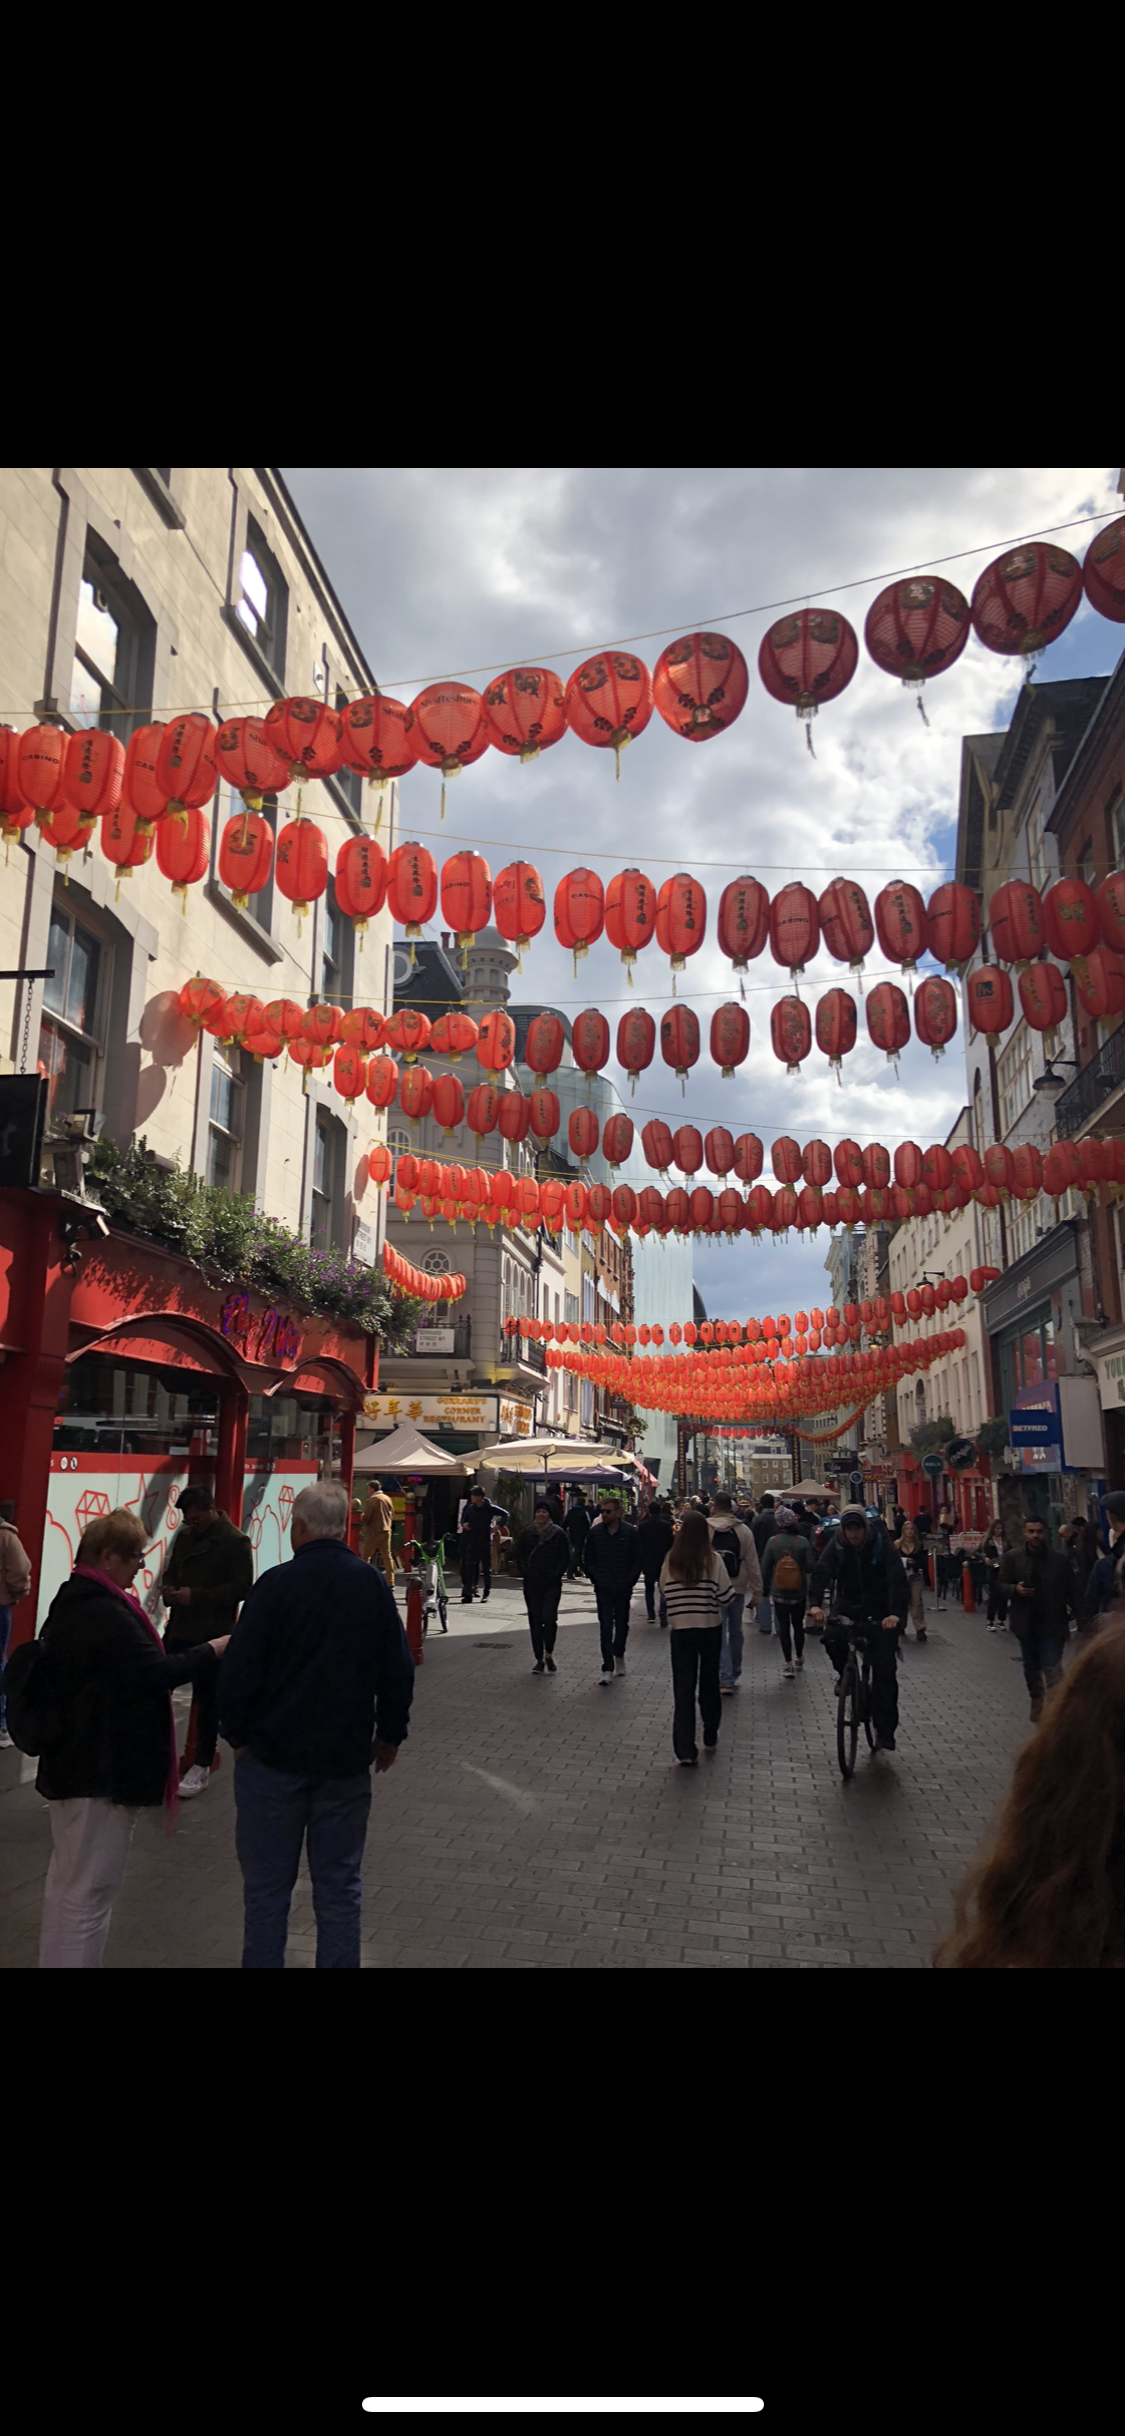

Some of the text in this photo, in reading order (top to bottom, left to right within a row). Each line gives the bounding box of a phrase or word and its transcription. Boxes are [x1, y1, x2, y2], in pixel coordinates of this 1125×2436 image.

[22, 754, 60, 765] CASINO
[135, 760, 155, 771] CAS
[776, 917, 809, 926] CASINO
[436, 1397, 487, 1405] GERRARD'S
[444, 1407, 481, 1415] CORNER
[423, 1415, 486, 1423] RESTAURANT
[1012, 1424, 1048, 1432] BETFRED
